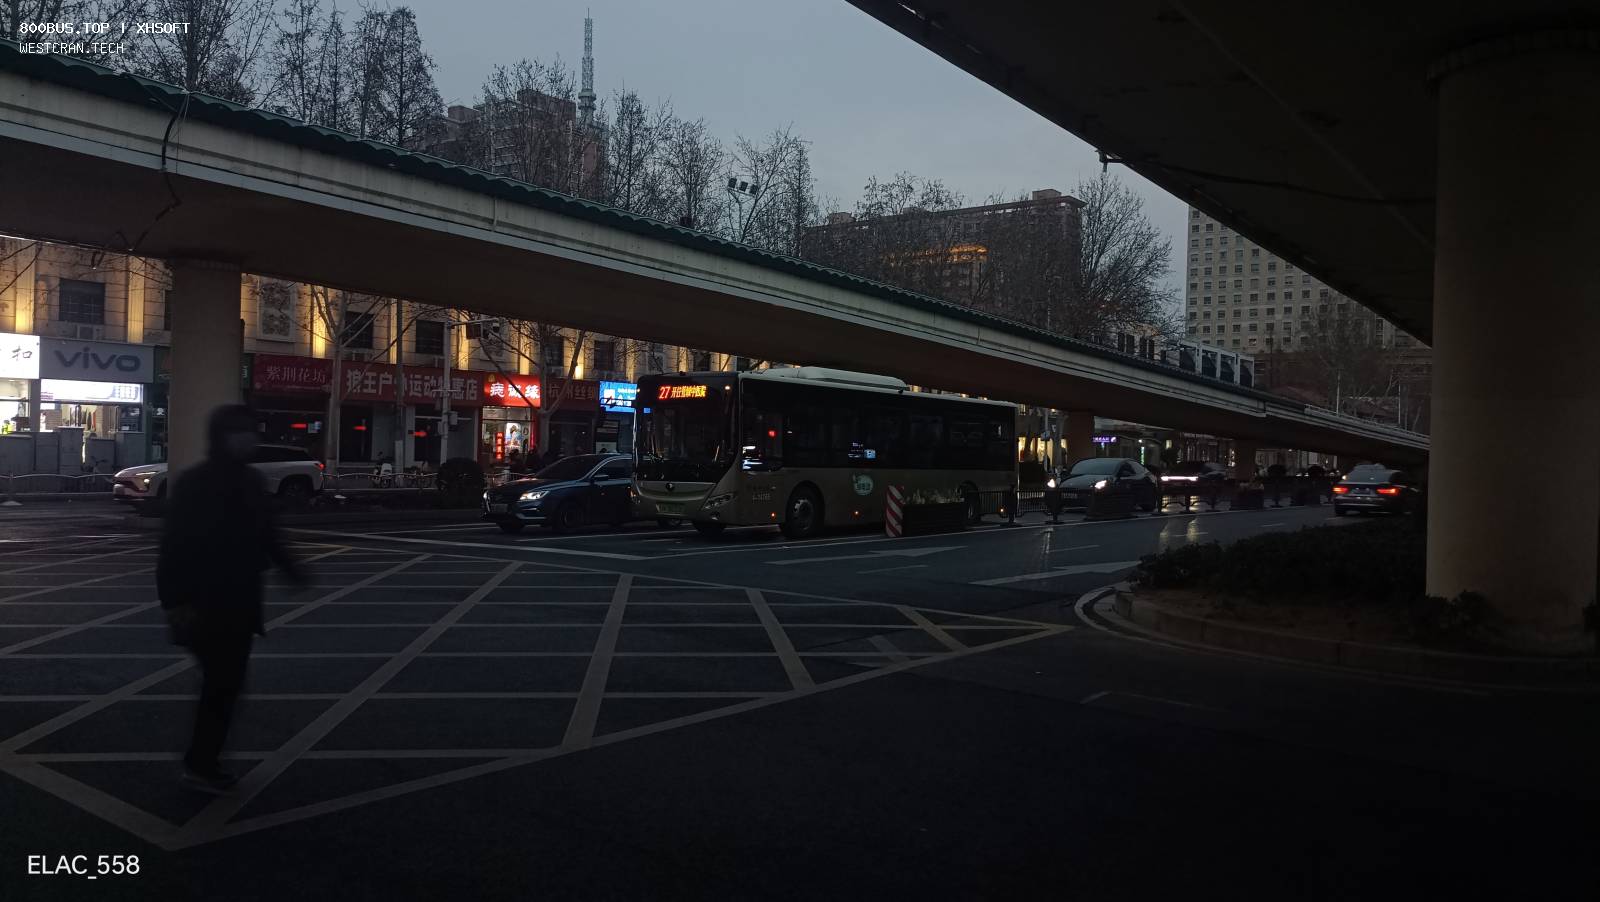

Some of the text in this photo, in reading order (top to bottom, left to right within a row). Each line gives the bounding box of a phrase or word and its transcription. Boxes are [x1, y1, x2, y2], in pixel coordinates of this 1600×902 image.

[54, 346, 141, 372] vivo
[263, 364, 327, 383] 紫荆花坊
[659, 386, 671, 399] 27
